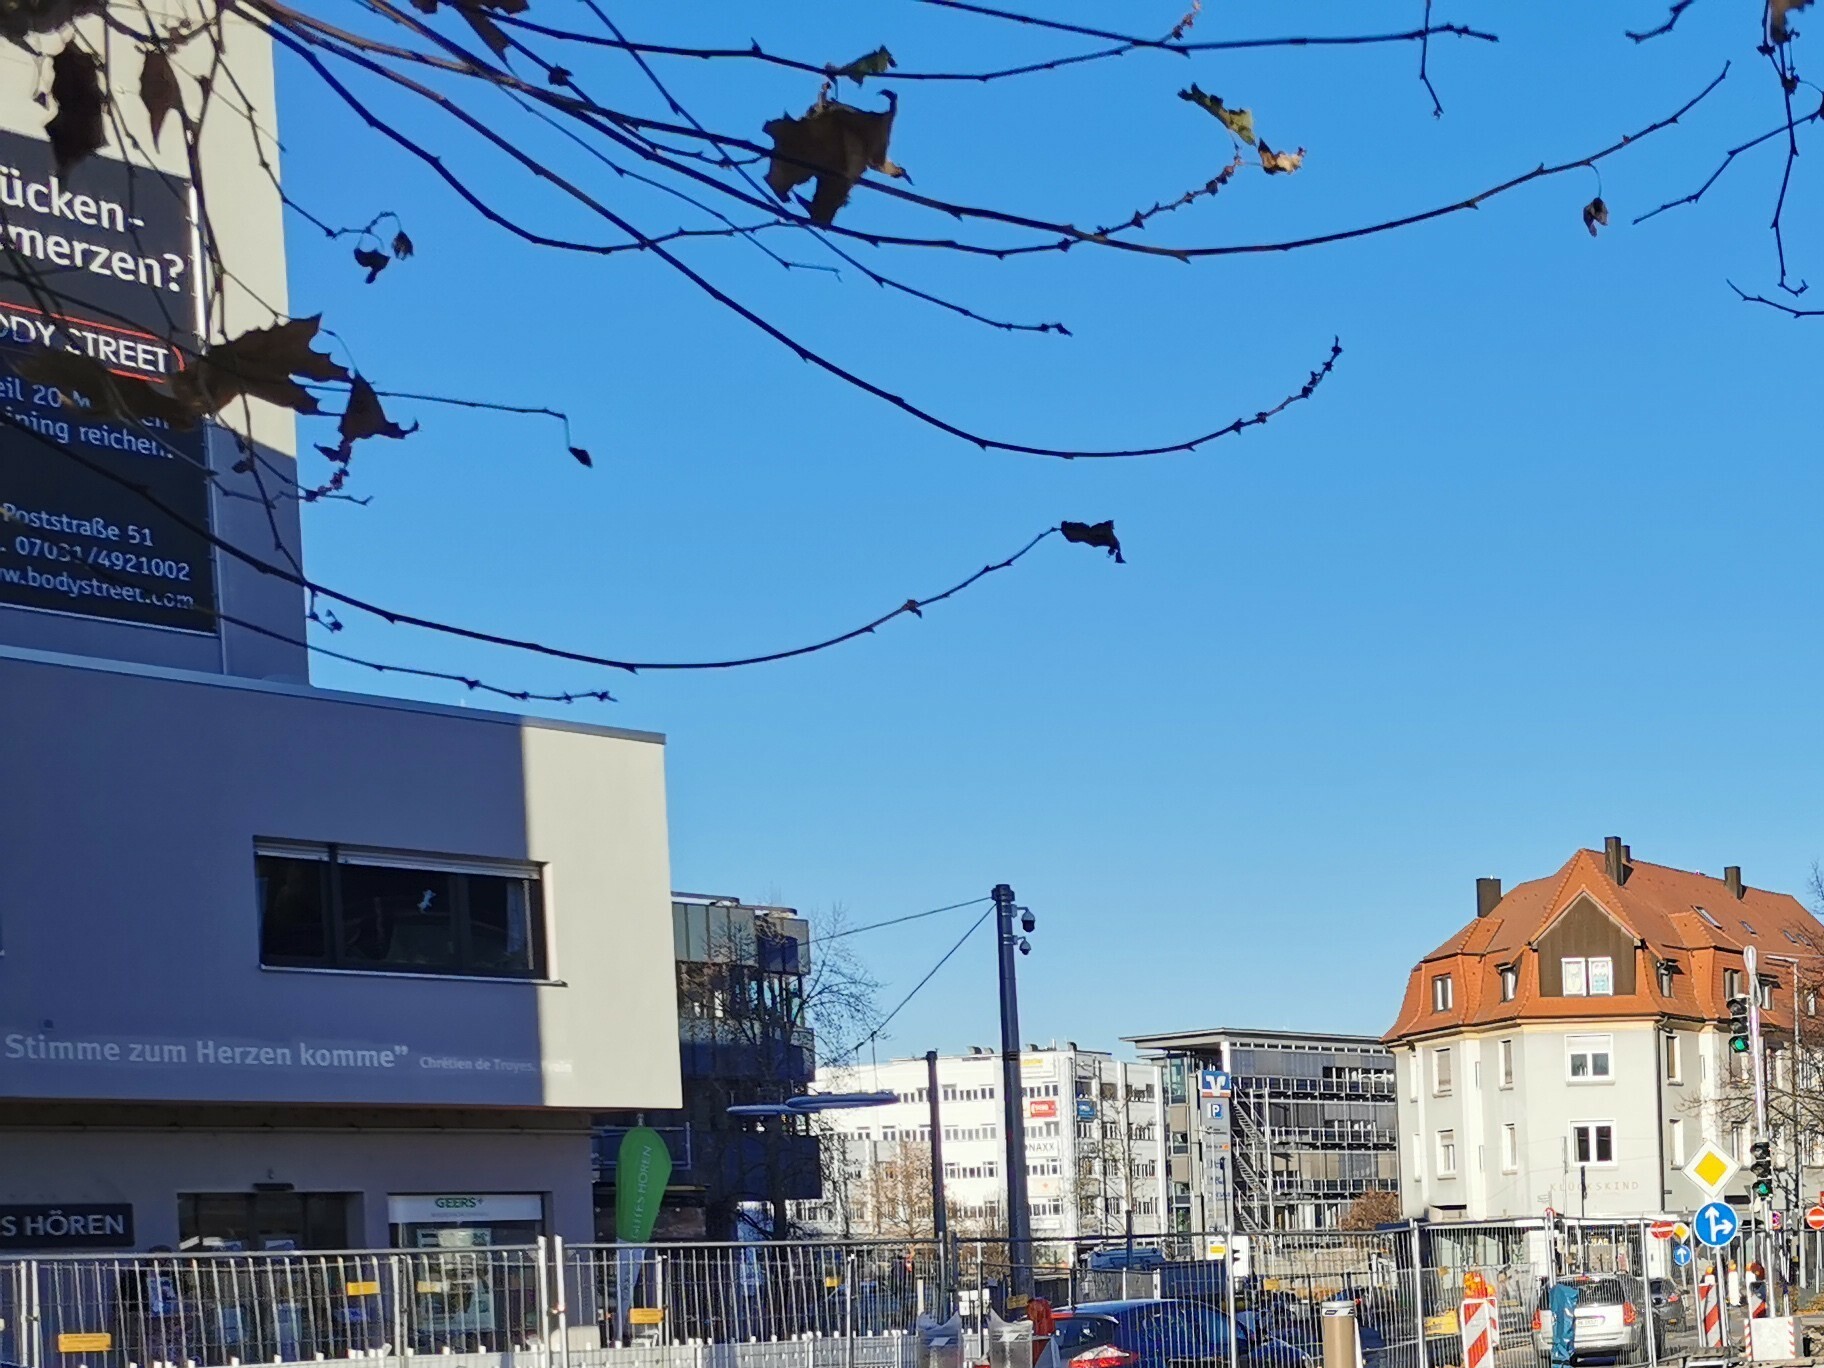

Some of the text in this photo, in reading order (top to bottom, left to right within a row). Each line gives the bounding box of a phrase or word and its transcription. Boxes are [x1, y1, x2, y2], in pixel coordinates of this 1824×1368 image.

[0, 224, 185, 293] merzen?
[32, 384, 63, 408] 20
[2, 503, 154, 547] Poststraße 51
[15, 536, 191, 581] 07031/4921002
[0, 566, 194, 610] w.bodystreet.com
[5, 1034, 120, 1060] Stimme
[128, 1043, 187, 1063] zum
[196, 1040, 292, 1065] Herzen
[475, 1057, 491, 1071] de
[1026, 1142, 1055, 1152] NAXX
[435, 1197, 477, 1209] GEERS
[25, 1209, 125, 1236] HÖREN
